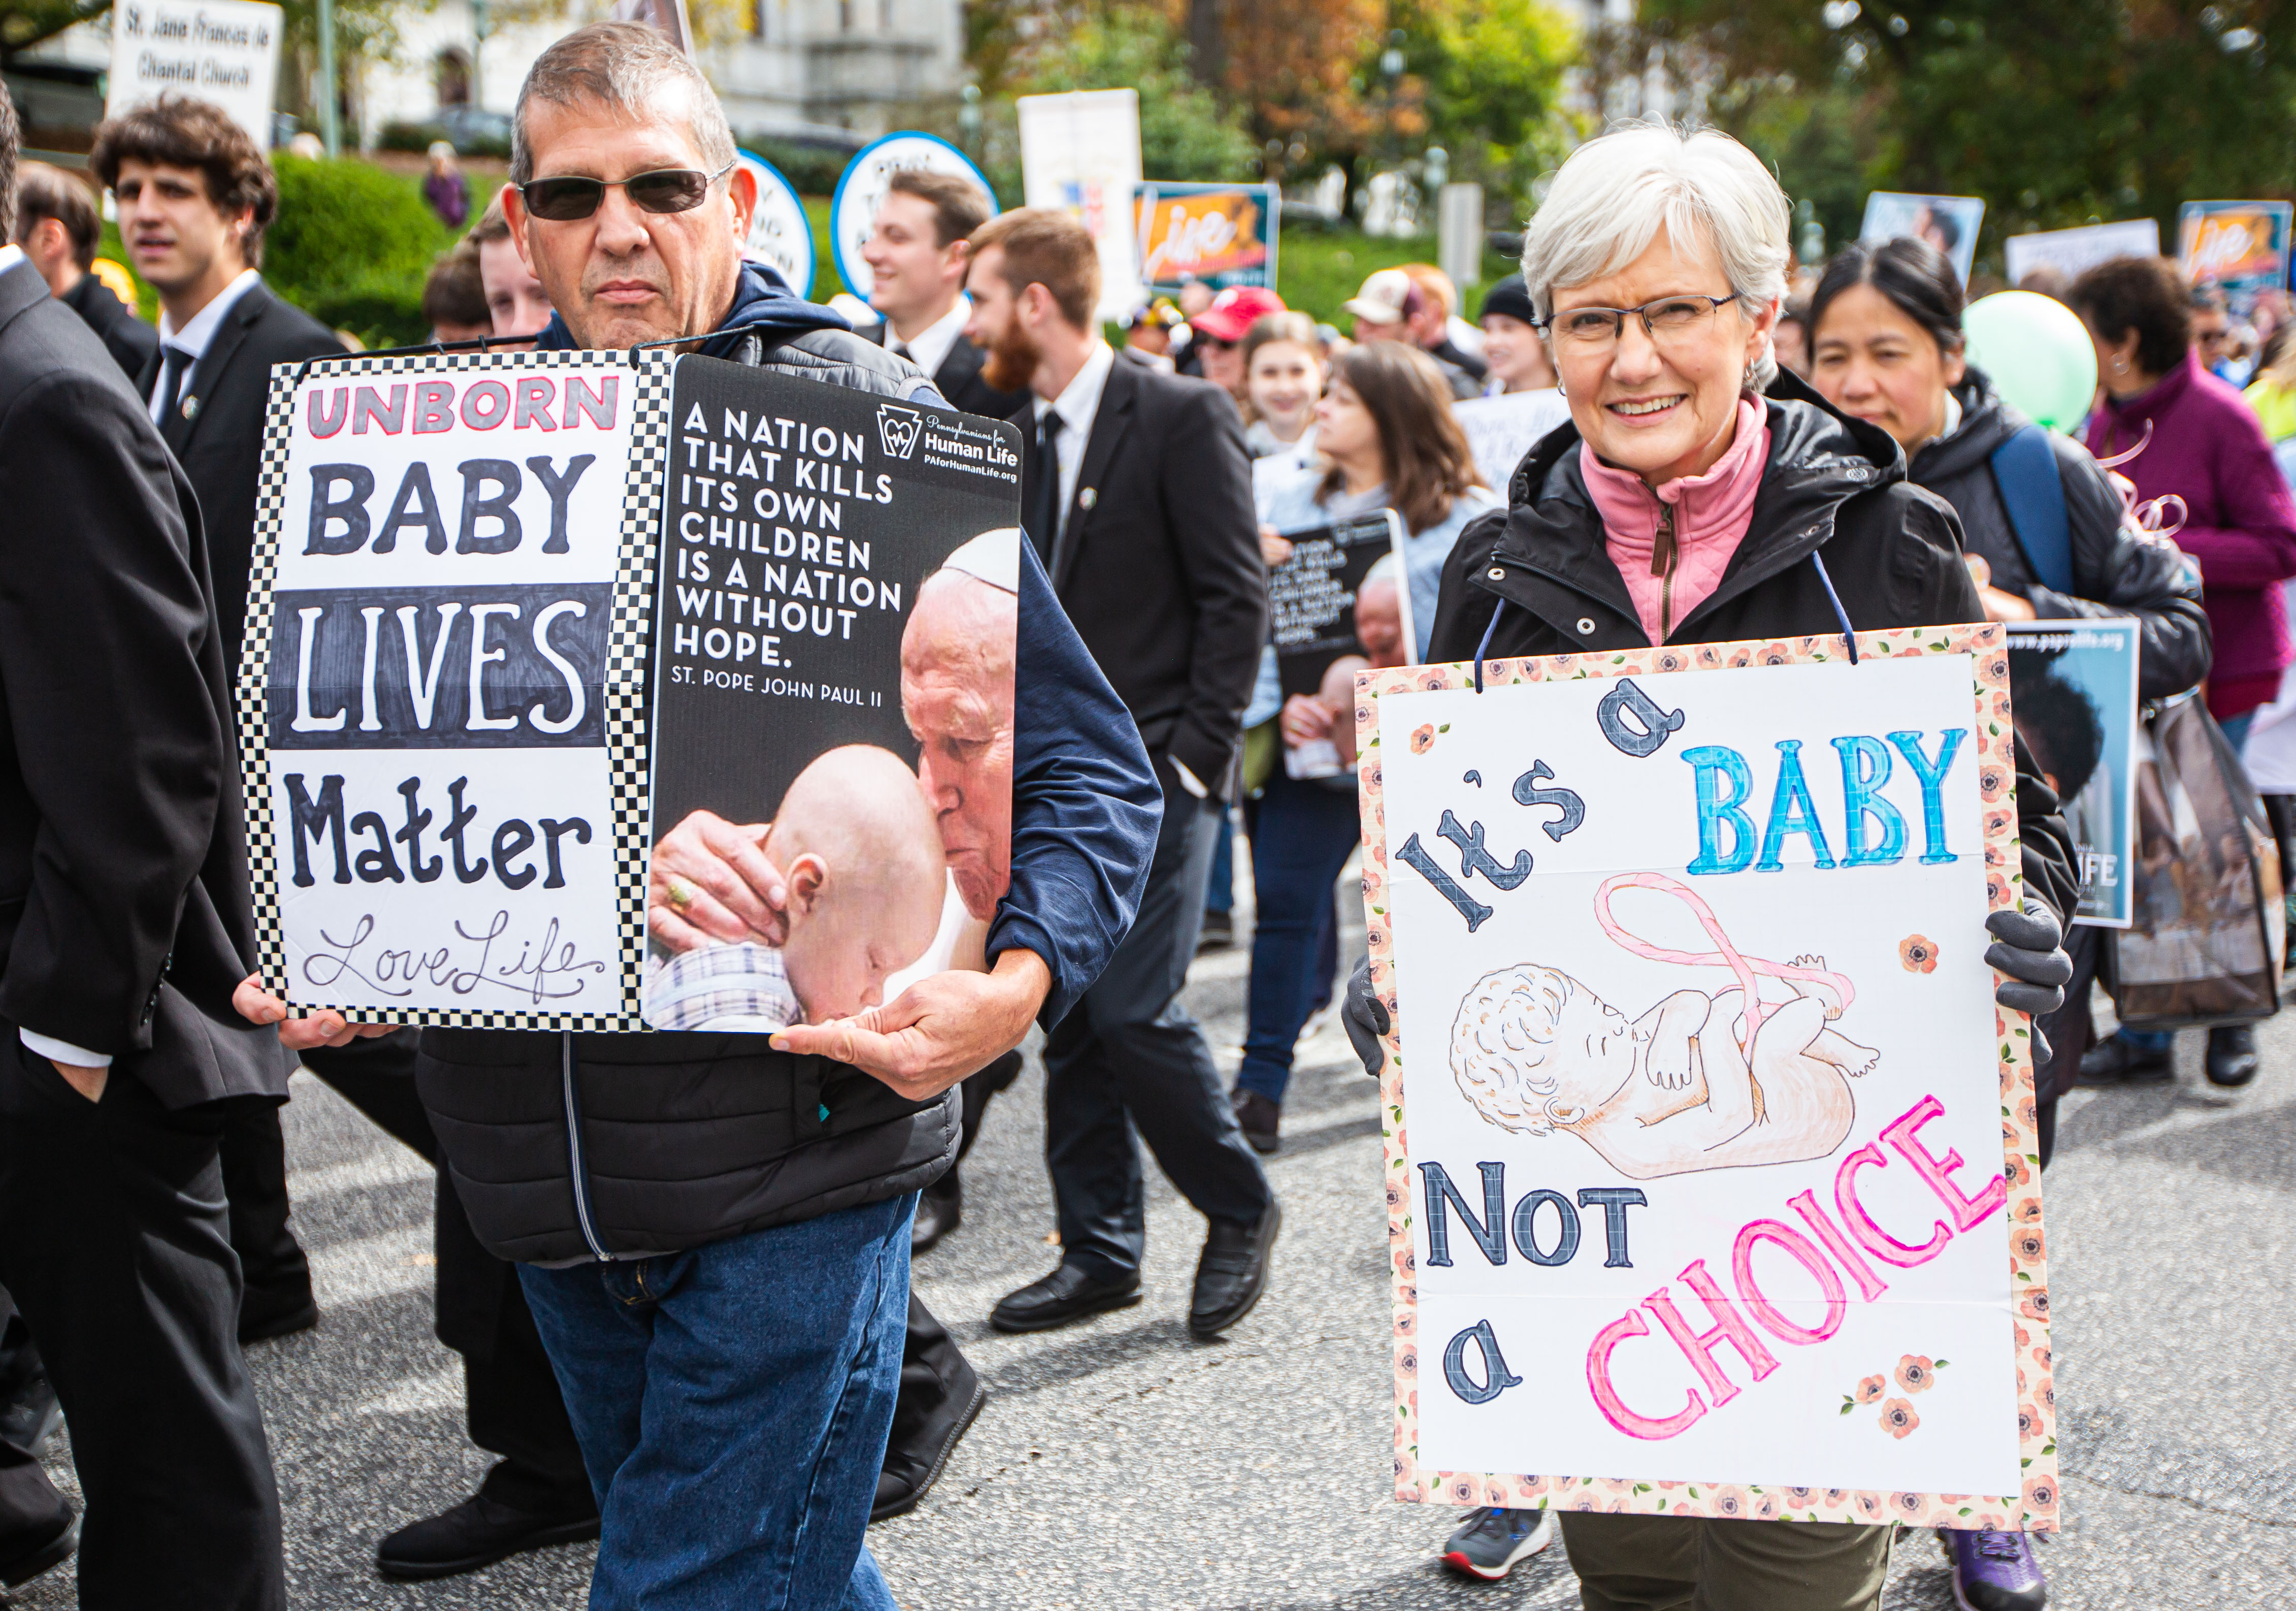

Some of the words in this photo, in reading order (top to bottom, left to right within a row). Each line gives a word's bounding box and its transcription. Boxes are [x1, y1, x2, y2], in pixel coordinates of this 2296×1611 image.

[308, 376, 619, 438] UNBORN
[684, 401, 708, 433] A
[724, 407, 864, 464] NATION
[927, 415, 992, 441] Pennsylvanians
[993, 429, 1006, 448] for
[683, 436, 781, 482] THAT
[796, 458, 892, 504] KILLS
[924, 454, 1018, 484] PAforHumanLife.org
[925, 432, 983, 460] Human
[987, 445, 1018, 467] Life
[302, 454, 596, 555] BABY
[681, 474, 738, 512] ITS
[754, 488, 841, 531] OWN
[680, 512, 870, 571] CHILDREN
[678, 548, 710, 582] IS
[725, 558, 748, 588] A
[765, 562, 901, 612] NATION
[676, 585, 857, 639] WITHOUT
[291, 601, 586, 733] LIVES
[674, 623, 792, 668] HOPE.
[671, 665, 696, 684] ST.
[704, 669, 753, 692] POPE
[761, 677, 813, 699] JOHN
[822, 684, 864, 705] PAUL
[871, 691, 881, 707] II
[283, 773, 592, 890] Matter
[1395, 759, 1586, 932] It's
[1597, 678, 1685, 757] a
[1680, 728, 1969, 876] BABY
[2078, 853, 2118, 887] IFE
[1418, 1161, 1648, 1268] NOT
[1586, 1093, 2009, 1442] CHOICE
[1443, 1318, 1523, 1405] a
